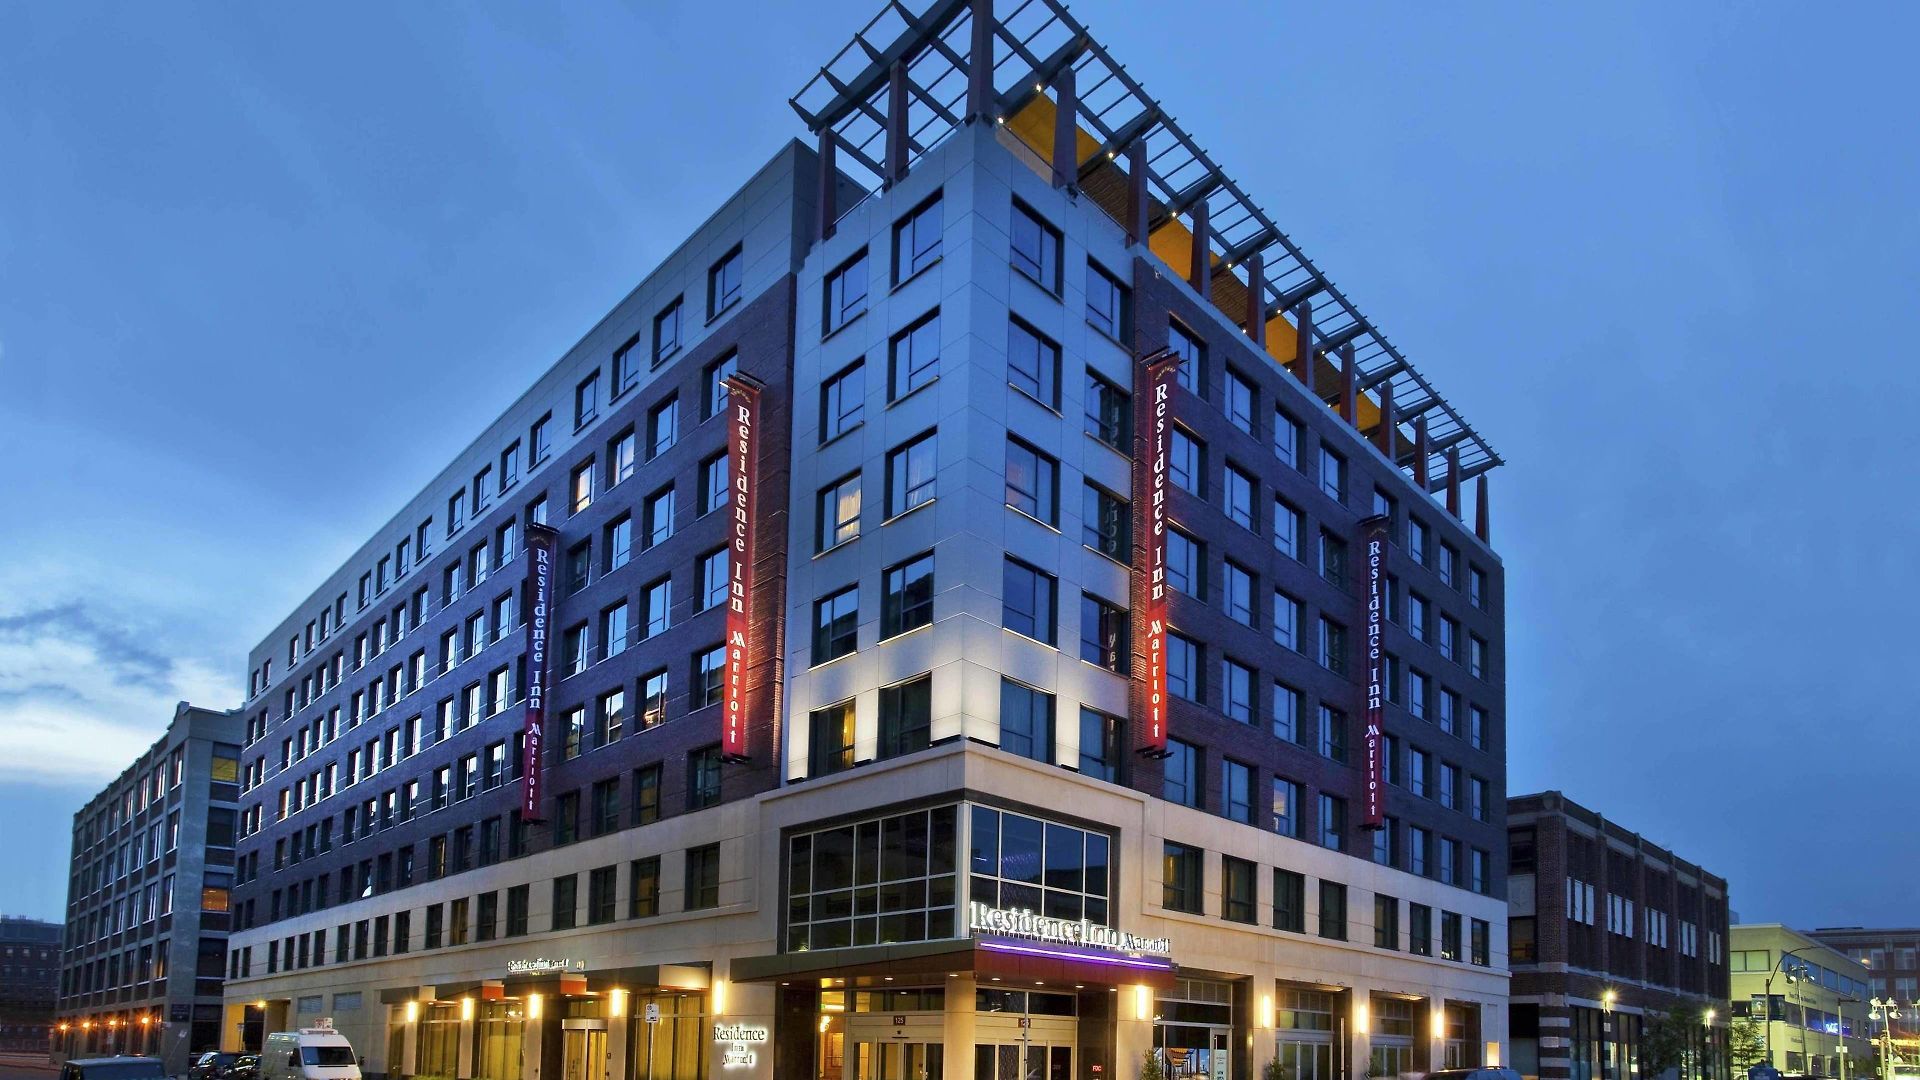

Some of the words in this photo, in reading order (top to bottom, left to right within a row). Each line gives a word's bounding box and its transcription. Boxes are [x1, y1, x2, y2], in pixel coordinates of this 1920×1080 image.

[734, 404, 751, 552] Residence
[1154, 383, 1168, 536] Residence
[533, 548, 549, 662] Residence
[731, 561, 745, 614] Inn
[1151, 545, 1164, 601] Inn
[1368, 540, 1381, 660] Residence
[529, 670, 542, 709] Inn
[729, 630, 746, 744] Marriott
[1147, 620, 1163, 738] Marriott
[1368, 667, 1380, 710] Inn
[528, 722, 542, 810] Marriott
[1365, 724, 1380, 816] Marriott
[970, 900, 1081, 942] Residence
[713, 1026, 765, 1041] Residence
